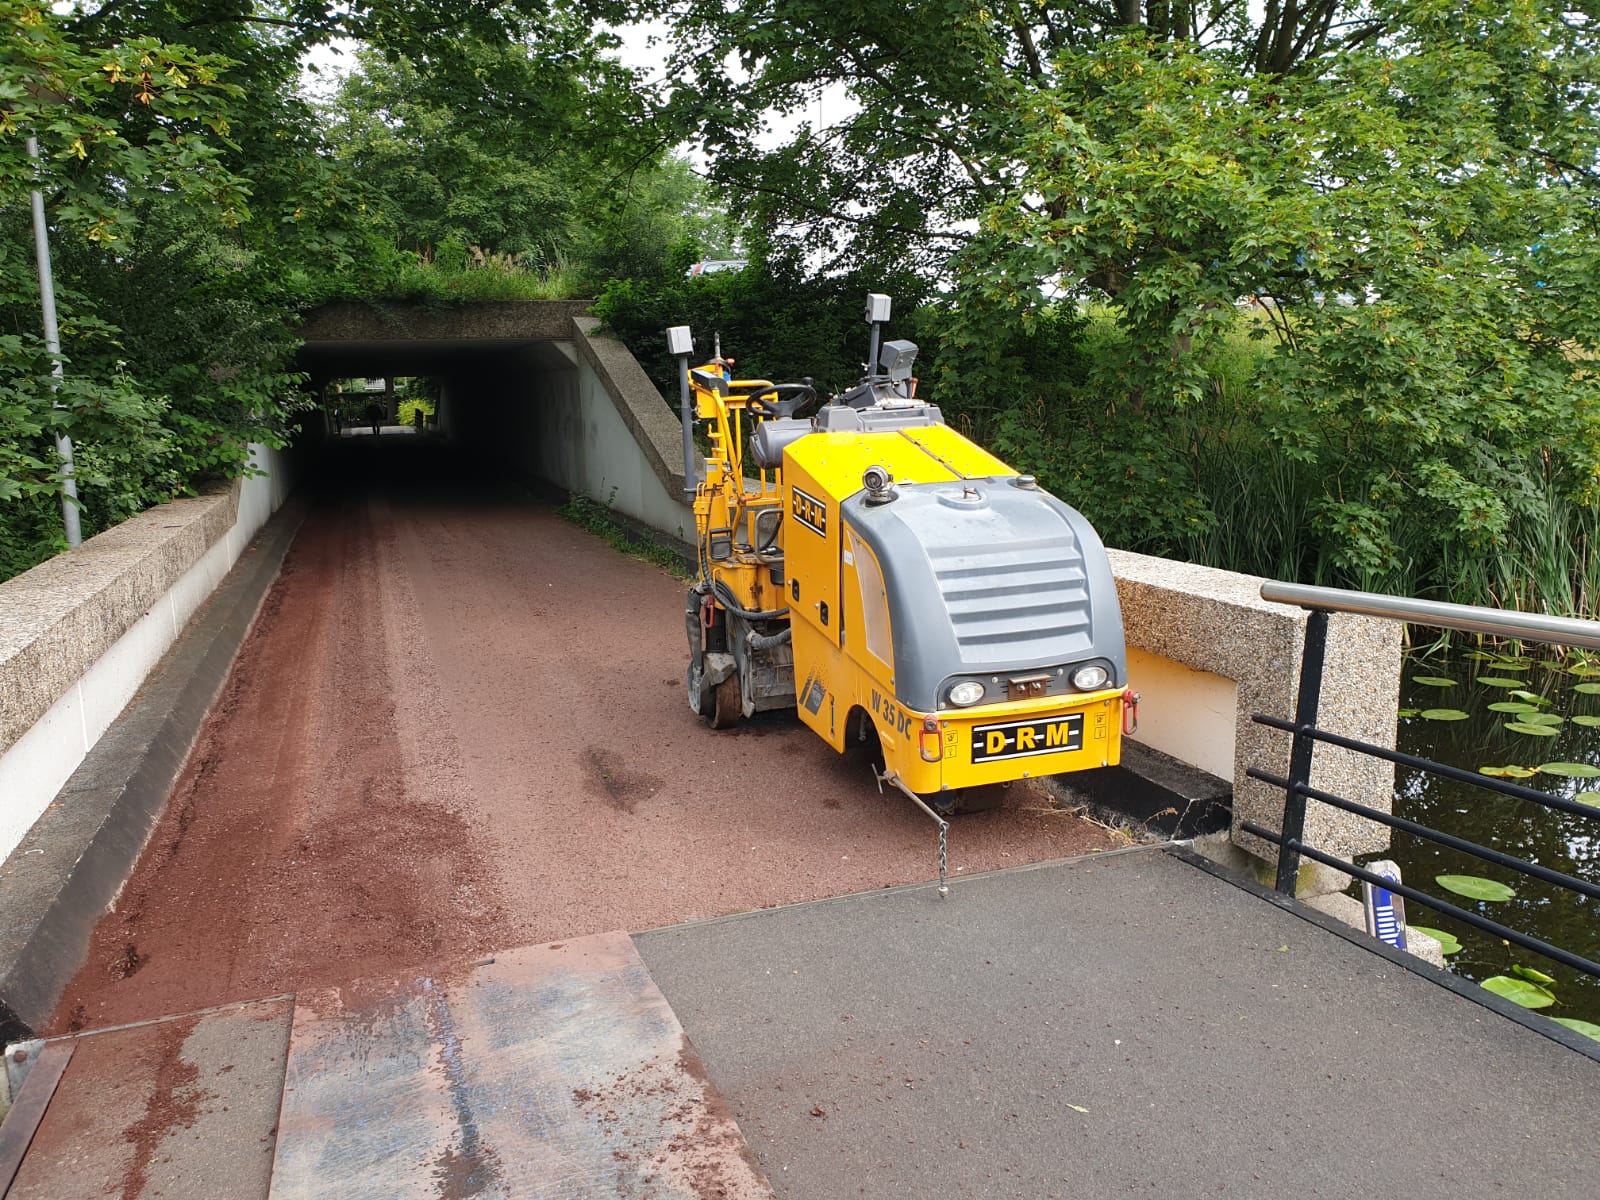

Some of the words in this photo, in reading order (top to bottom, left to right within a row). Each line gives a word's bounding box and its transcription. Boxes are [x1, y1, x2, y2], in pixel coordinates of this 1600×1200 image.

[871, 688, 882, 714] W
[882, 699, 896, 727] 35
[897, 710, 913, 742] DC
